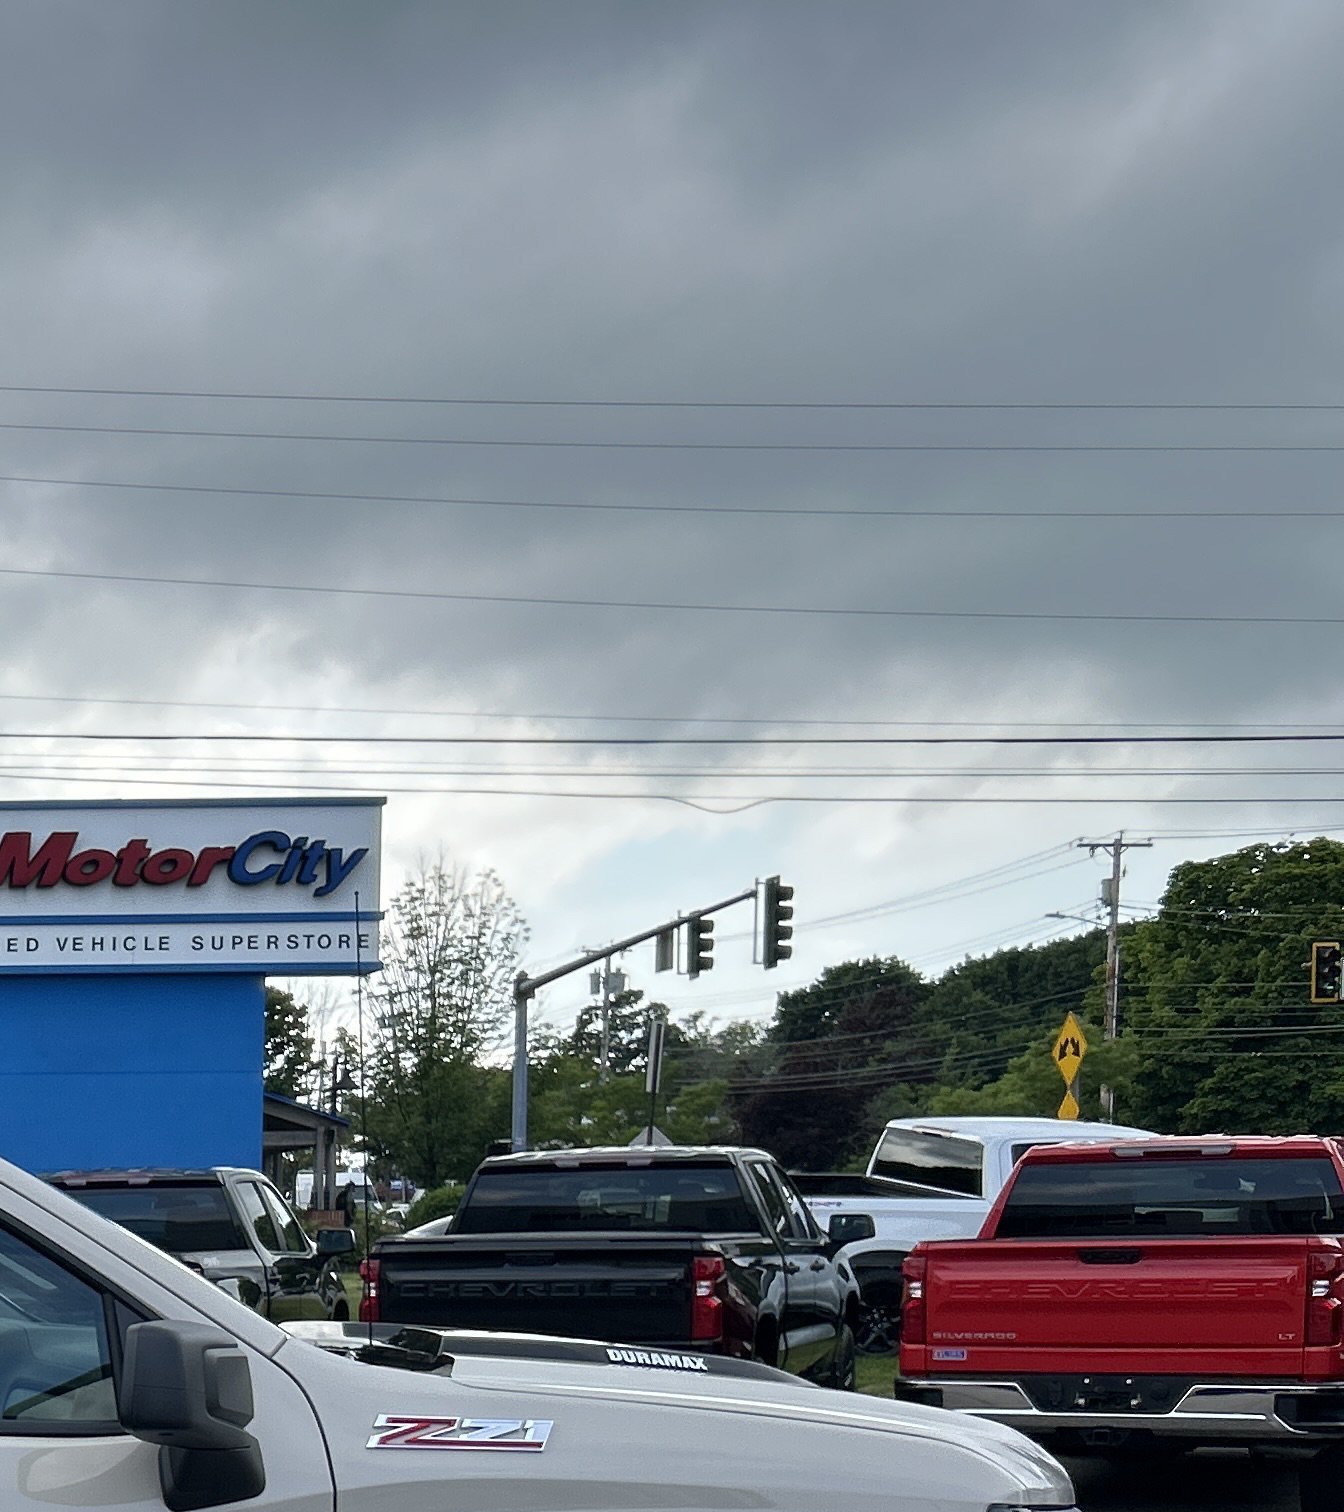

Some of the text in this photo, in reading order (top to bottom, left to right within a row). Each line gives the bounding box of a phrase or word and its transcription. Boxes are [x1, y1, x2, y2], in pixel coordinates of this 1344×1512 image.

[55, 936, 171, 952] VEHICLE
[191, 932, 371, 950] SUPERSTORE
[399, 1282, 670, 1298] CHEVROLET
[932, 1332, 1016, 1340] SILVERADO
[1278, 1332, 1296, 1340] LT
[606, 1348, 709, 1371] DURAMAX
[365, 1413, 555, 1452] Z71
